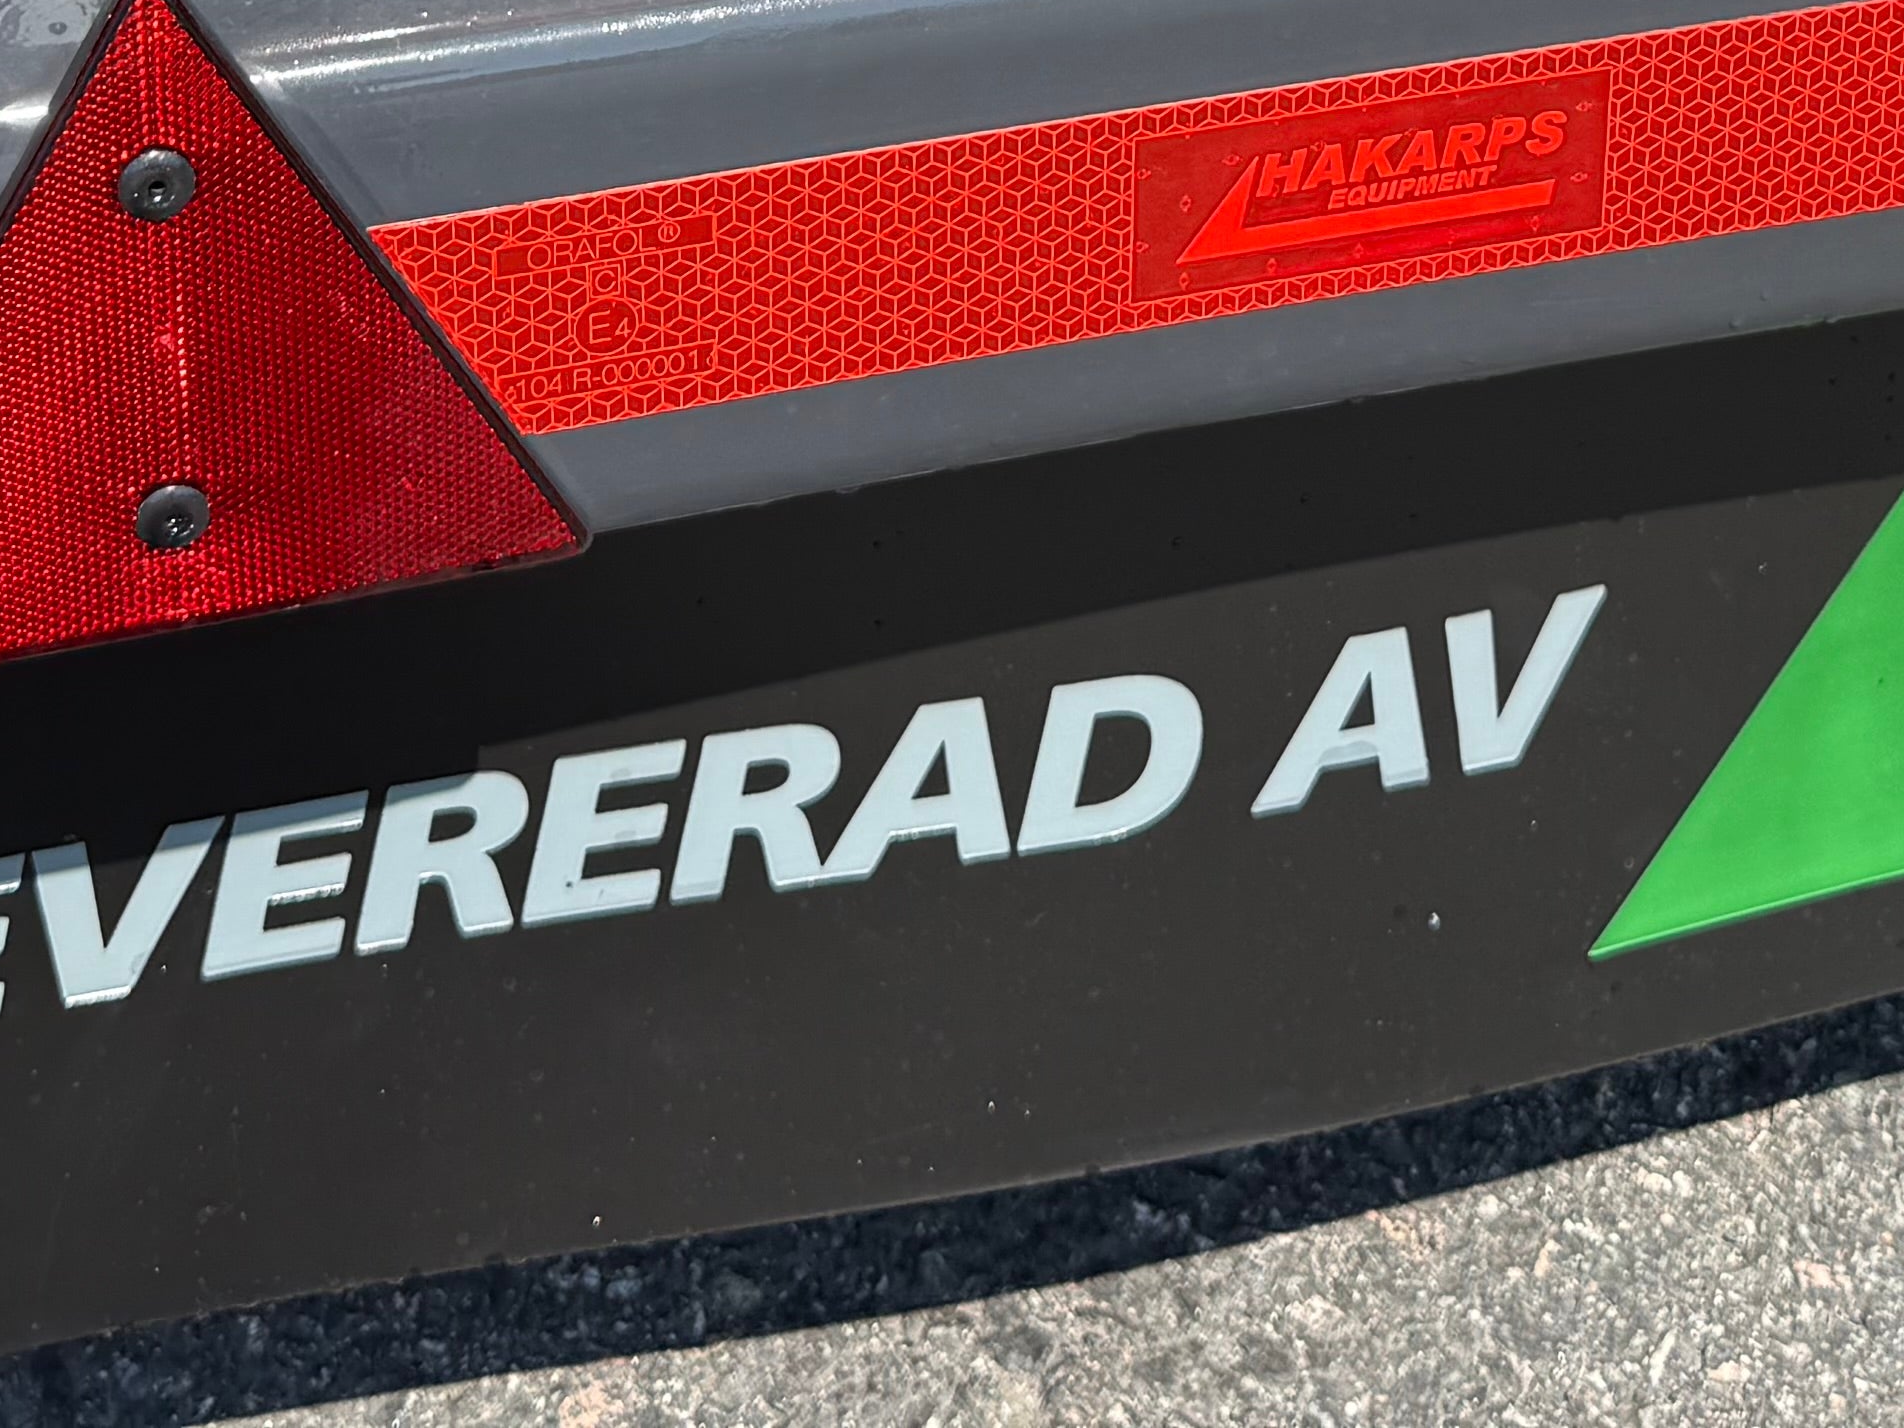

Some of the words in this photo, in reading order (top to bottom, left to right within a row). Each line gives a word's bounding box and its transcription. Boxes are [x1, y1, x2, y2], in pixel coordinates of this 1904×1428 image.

[1256, 110, 1568, 198] HAKARPS
[1327, 165, 1497, 210] EQUIPMENT
[526, 227, 657, 270] ORAFOL
[588, 309, 633, 345] E4
[515, 372, 562, 401] 104
[572, 348, 699, 392] R-000001
[1250, 583, 1608, 817] AV
